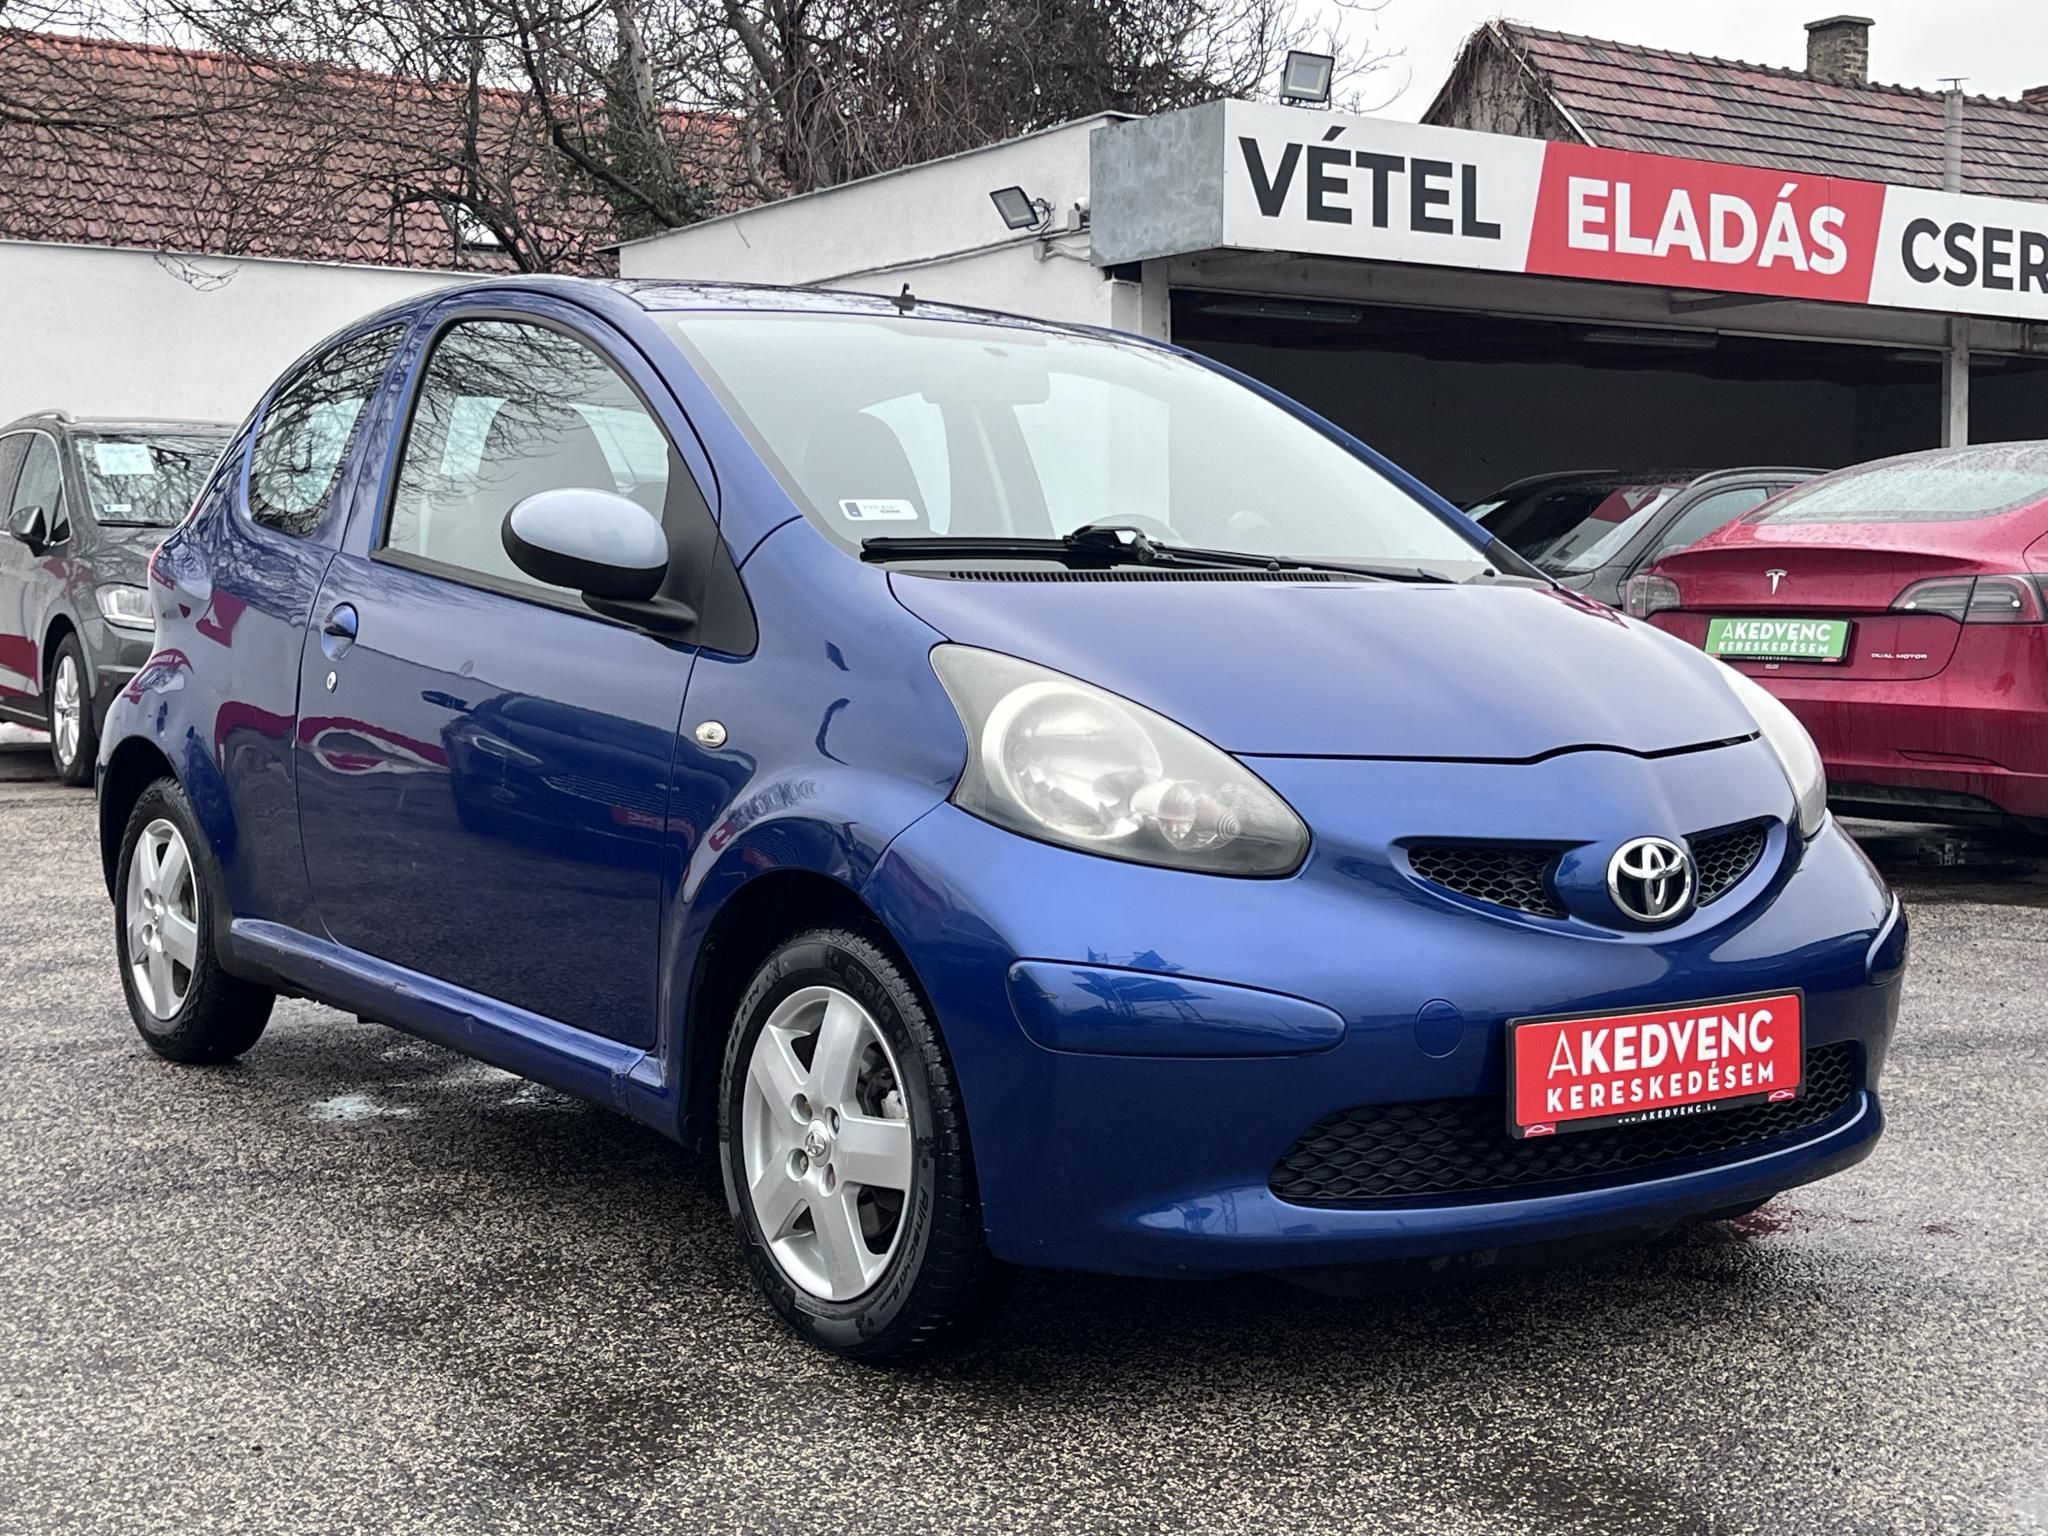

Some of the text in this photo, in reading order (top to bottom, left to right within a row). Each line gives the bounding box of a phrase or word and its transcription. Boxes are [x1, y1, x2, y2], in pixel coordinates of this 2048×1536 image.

[1238, 125, 2048, 295] VÉTEL ELADÁS CSER
[1717, 640, 1829, 654] KERESKEDÉSEM
[1546, 1060, 1774, 1114] KERESKEDÉSEM
